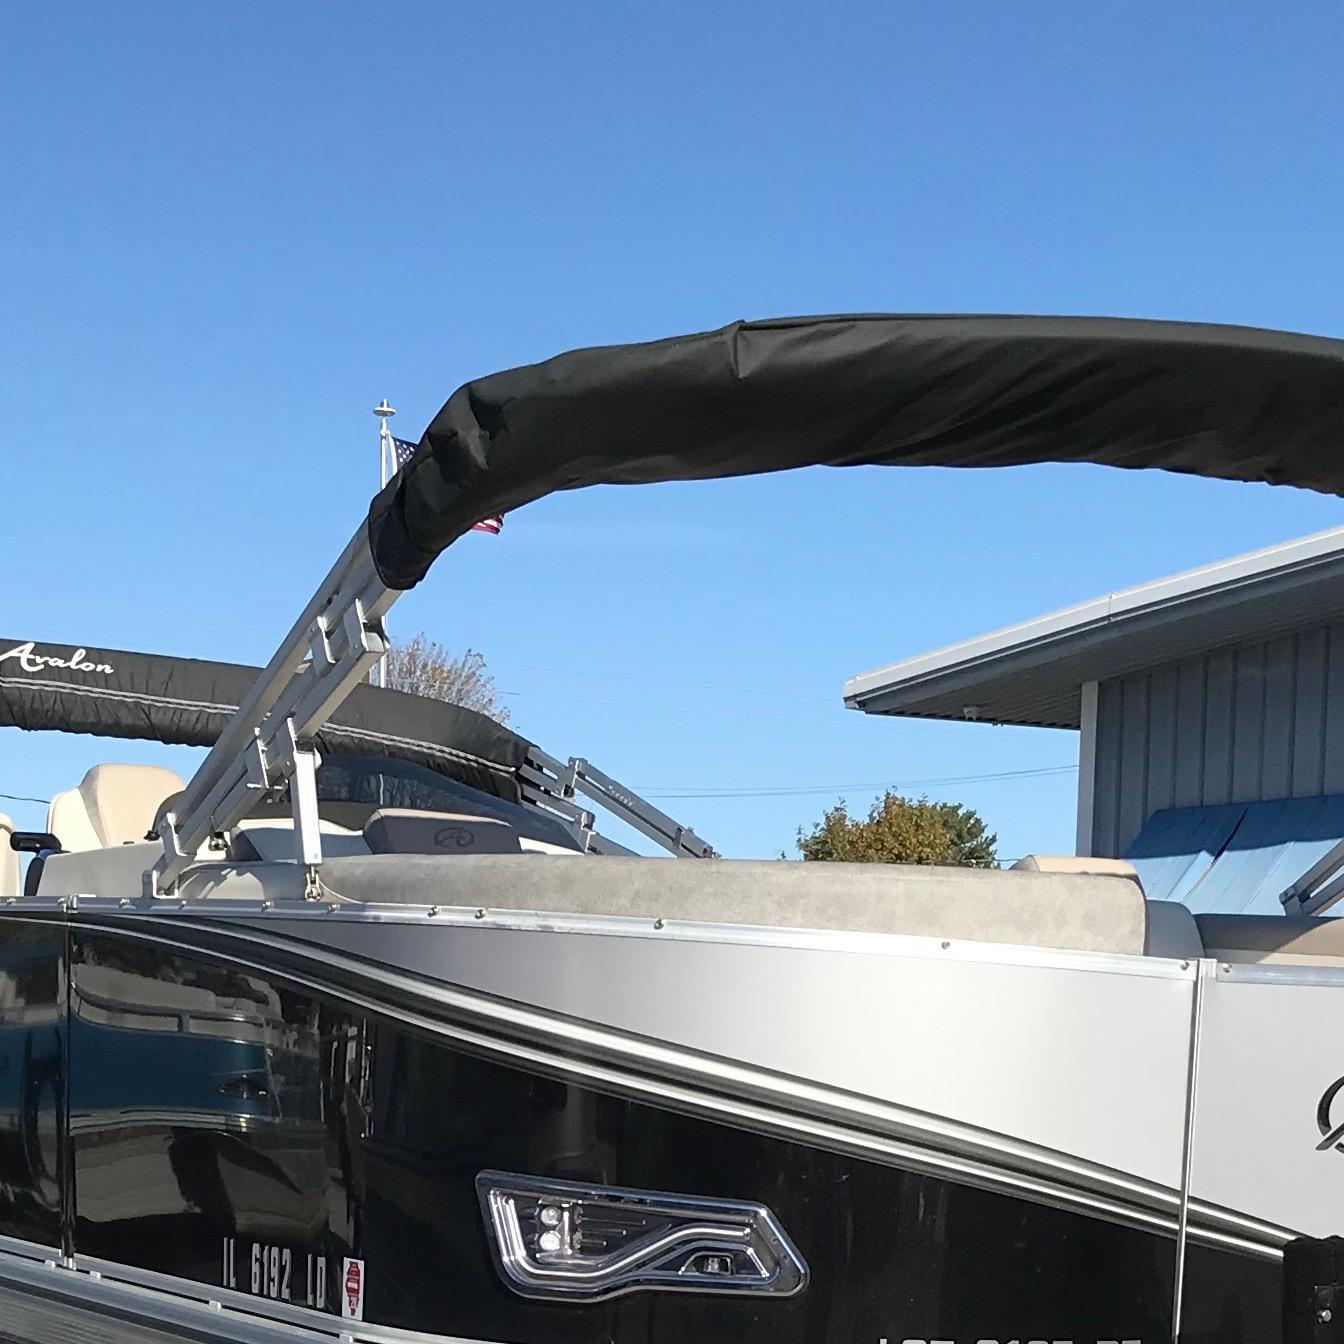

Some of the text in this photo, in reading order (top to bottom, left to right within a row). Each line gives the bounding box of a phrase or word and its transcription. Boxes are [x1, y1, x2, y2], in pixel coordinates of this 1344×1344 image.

[223, 1237, 237, 1288] IL
[251, 1243, 291, 1301] 6192
[307, 1254, 326, 1308] LD
